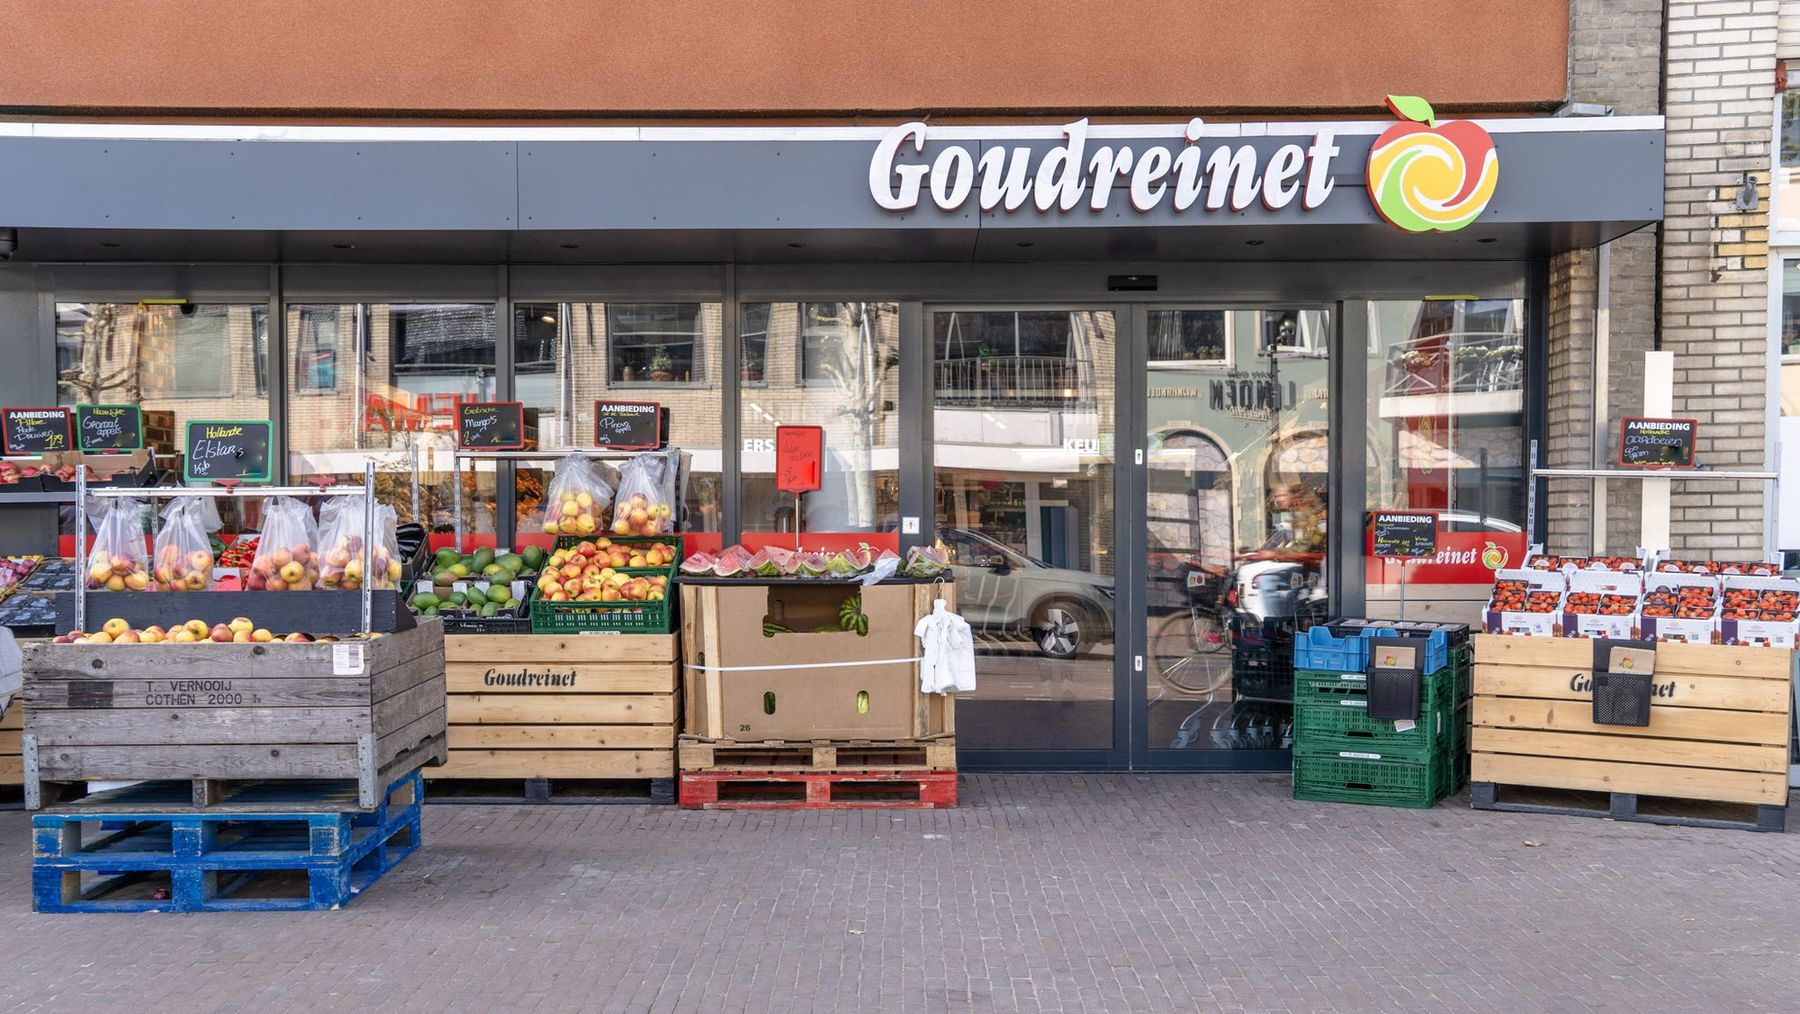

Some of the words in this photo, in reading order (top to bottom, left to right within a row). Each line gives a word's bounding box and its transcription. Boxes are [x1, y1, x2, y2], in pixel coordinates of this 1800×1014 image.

[869, 117, 1340, 212] Goudreinet
[601, 405, 655, 413] AANBIEDING
[9, 411, 65, 419] AANBIEDING
[1628, 422, 1690, 430] AANBIEDING
[1379, 515, 1432, 524] AANBIEDING
[484, 668, 577, 687] Goudreinet
[146, 681, 157, 692] T.
[170, 681, 232, 692] VERNOOIJ
[145, 694, 196, 705] COTHEN
[208, 693, 242, 705] 2000
[739, 724, 751, 732] 26
